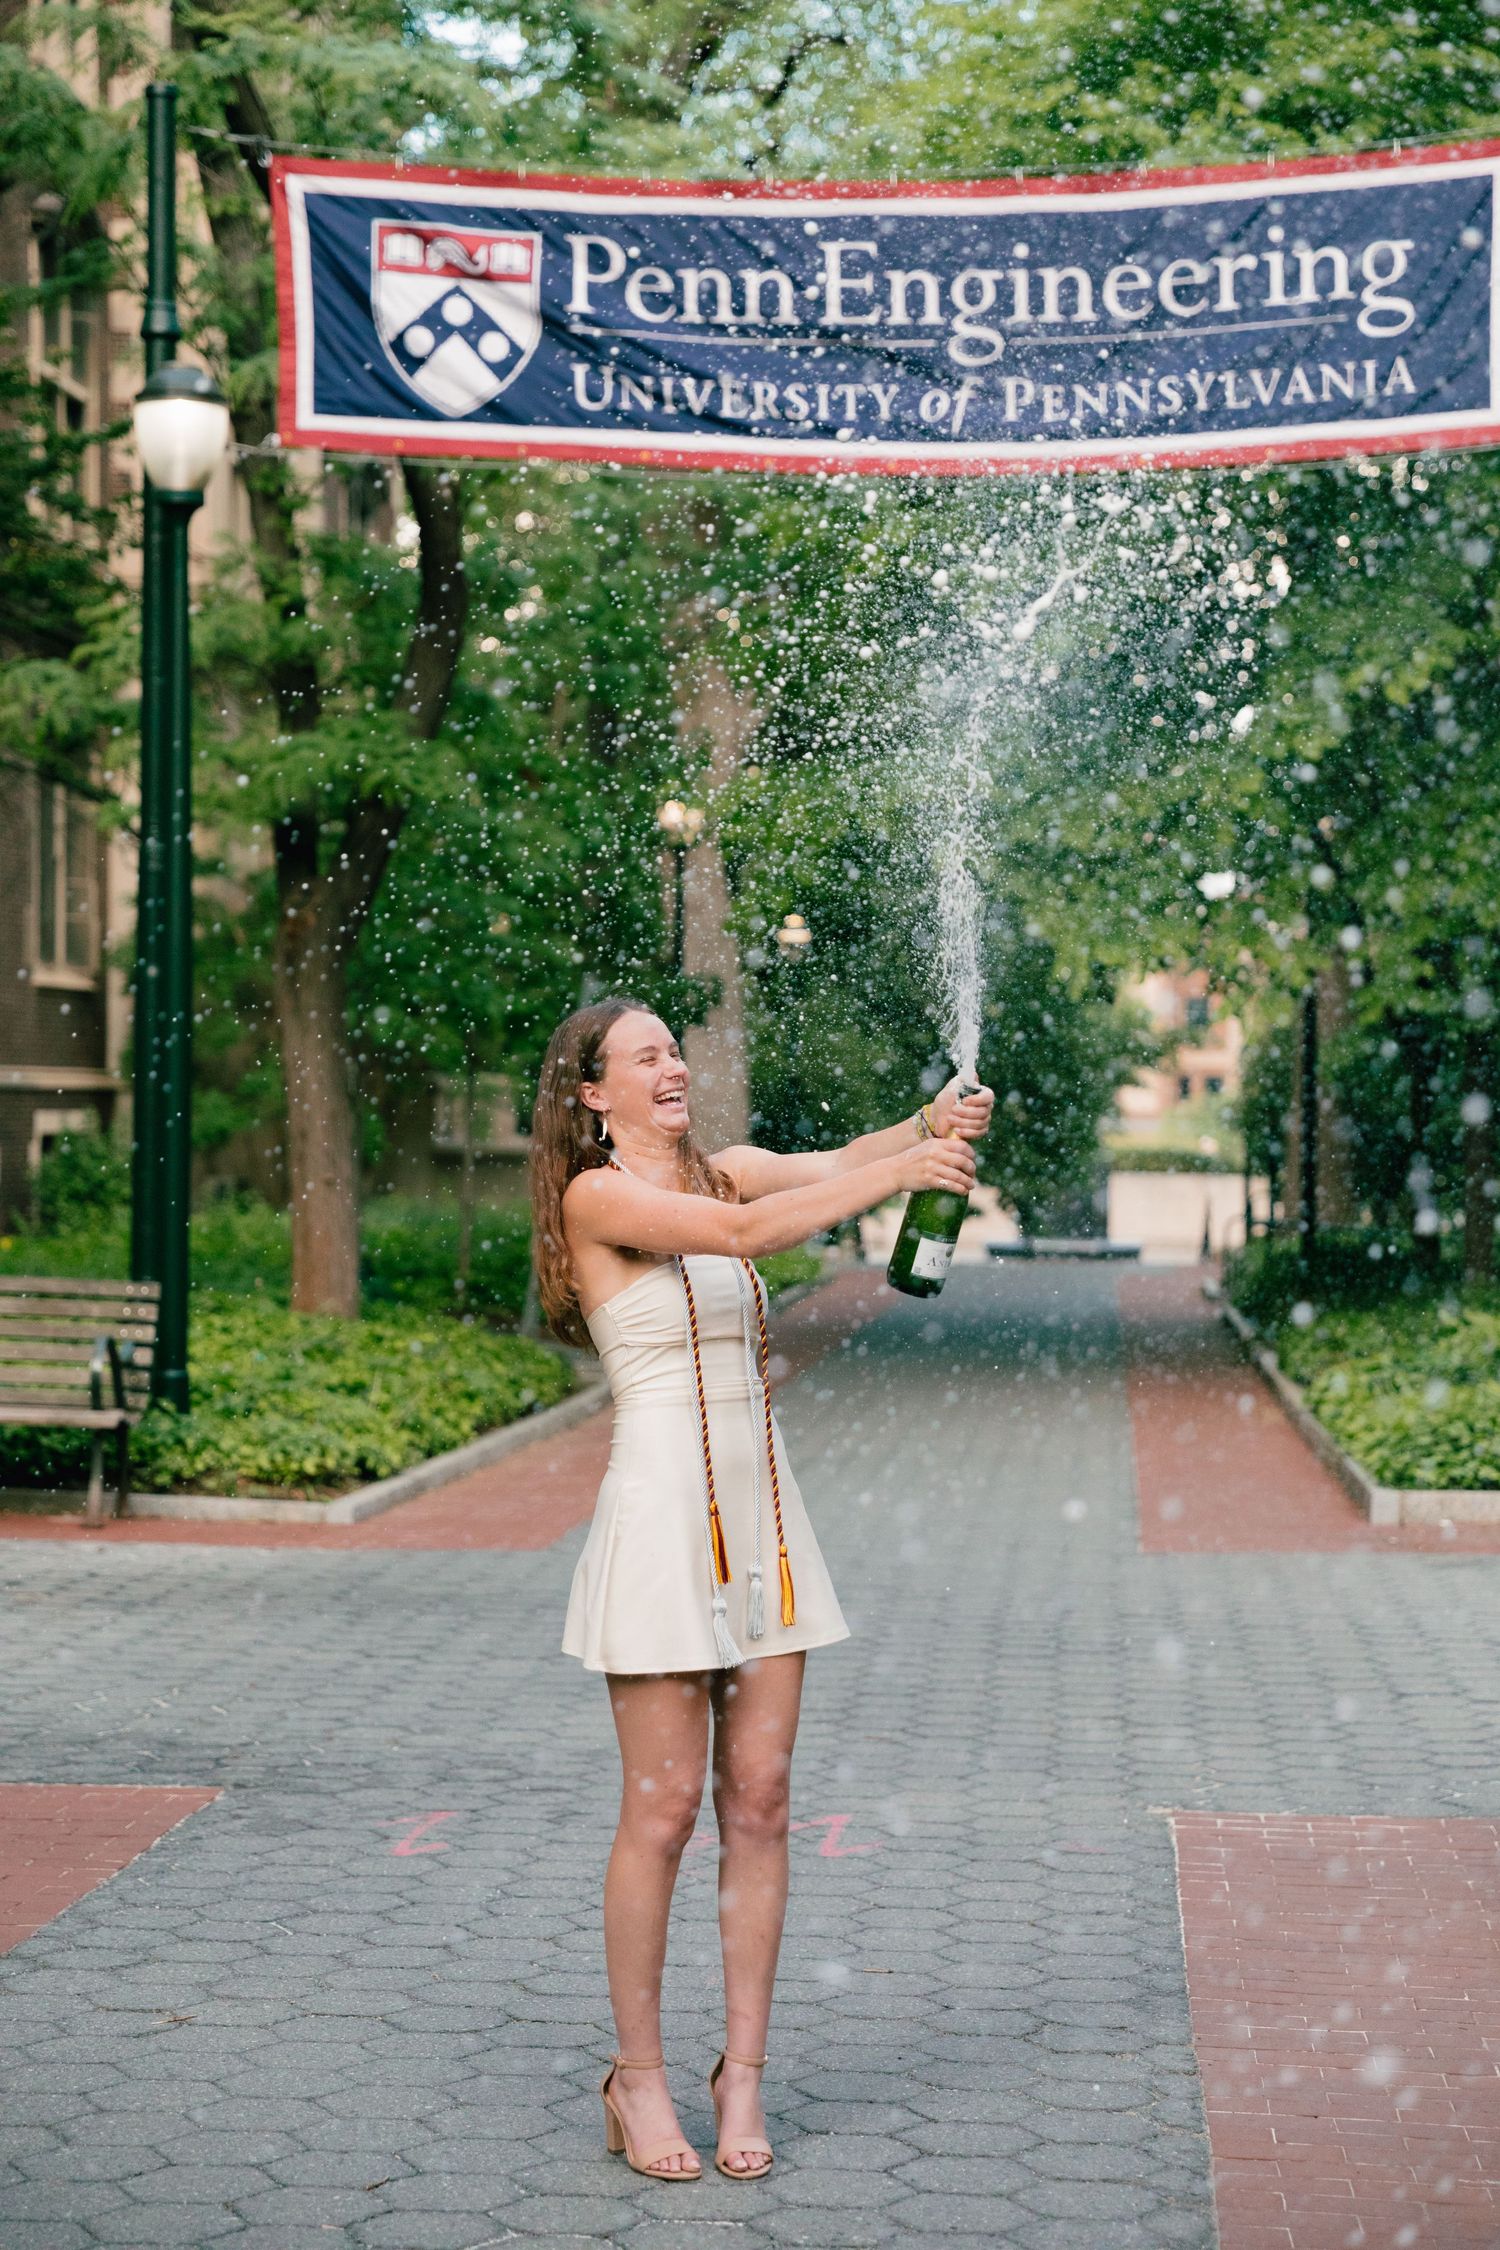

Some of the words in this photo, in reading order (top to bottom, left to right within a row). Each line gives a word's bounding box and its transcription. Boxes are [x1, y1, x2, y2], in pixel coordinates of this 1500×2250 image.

[565, 233, 800, 325] Penn
[817, 225, 1417, 367] Engineering
[570, 363, 899, 421] UNIVERSITY
[918, 376, 983, 434] of
[1002, 356, 1416, 423] PENNSYLVANIA
